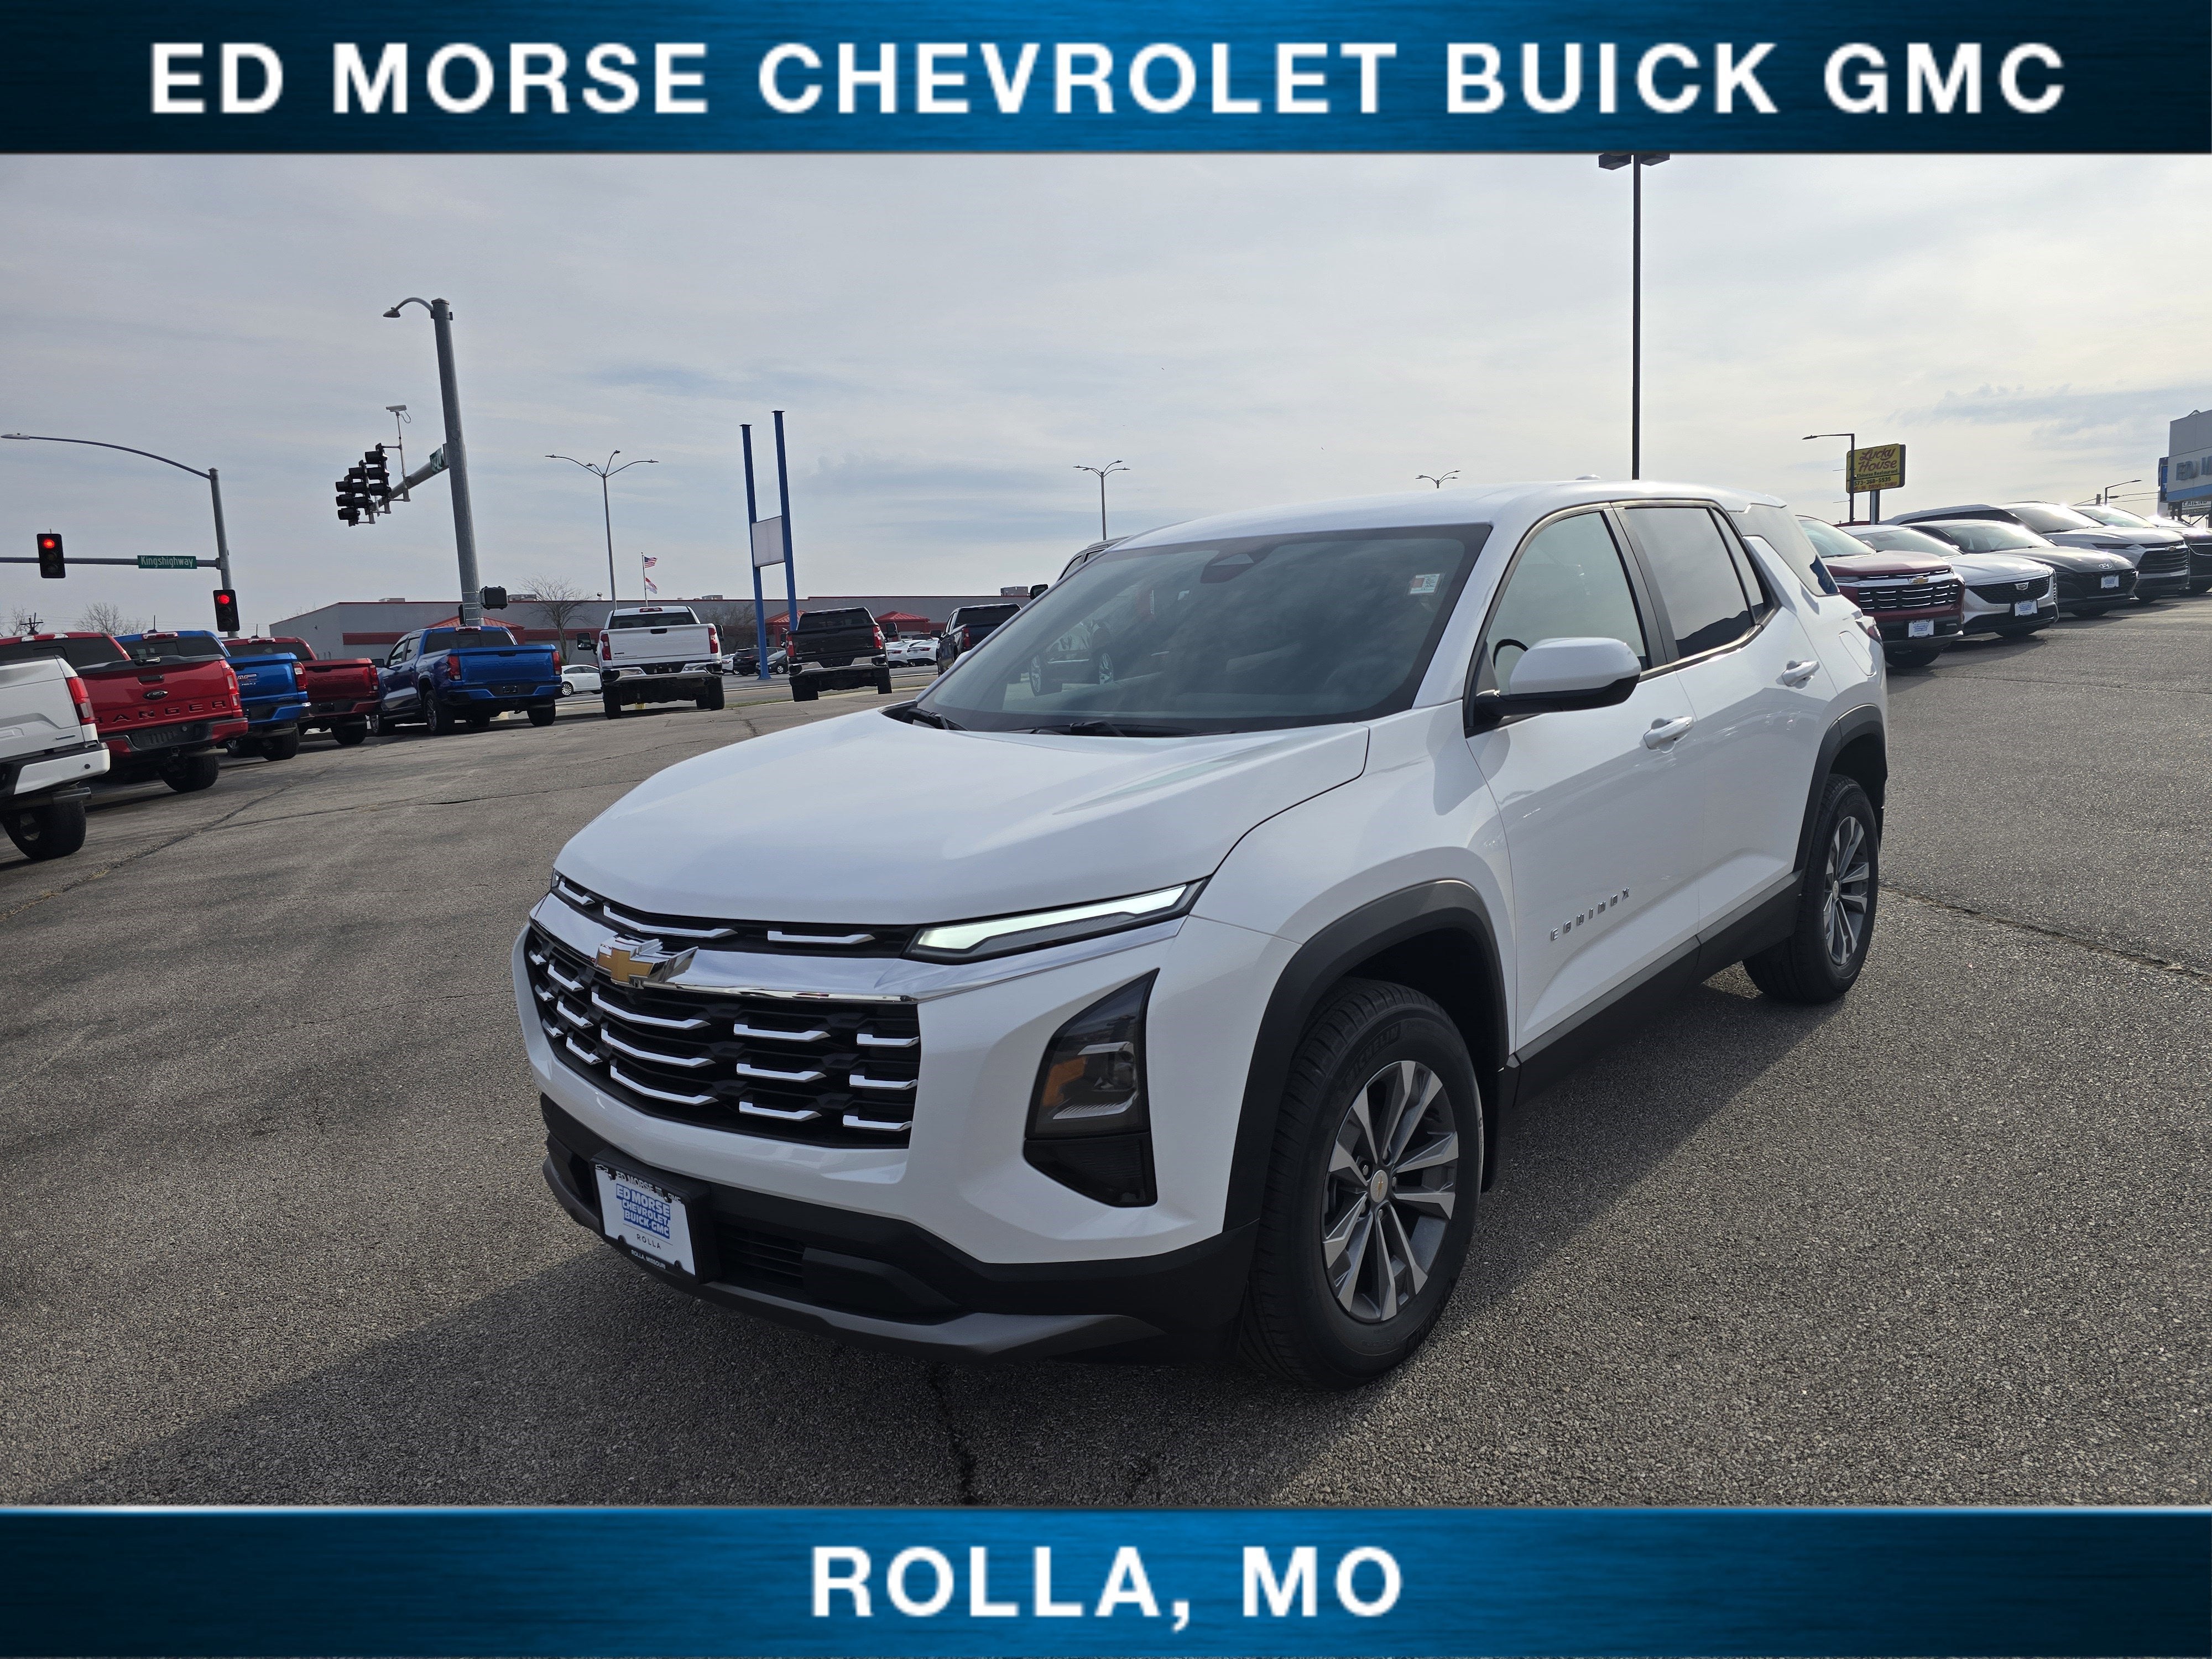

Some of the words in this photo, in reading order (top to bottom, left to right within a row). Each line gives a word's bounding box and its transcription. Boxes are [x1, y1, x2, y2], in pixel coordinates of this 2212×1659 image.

[1859, 447, 1896, 461] Lucky
[1858, 460, 1897, 472] House
[140, 556, 194, 568] Kingshighway
[1550, 886, 1630, 941] EQUINOX
[617, 1186, 631, 1201] ED
[632, 1190, 670, 1217] MORSE
[637, 1233, 661, 1250] ROLLA
